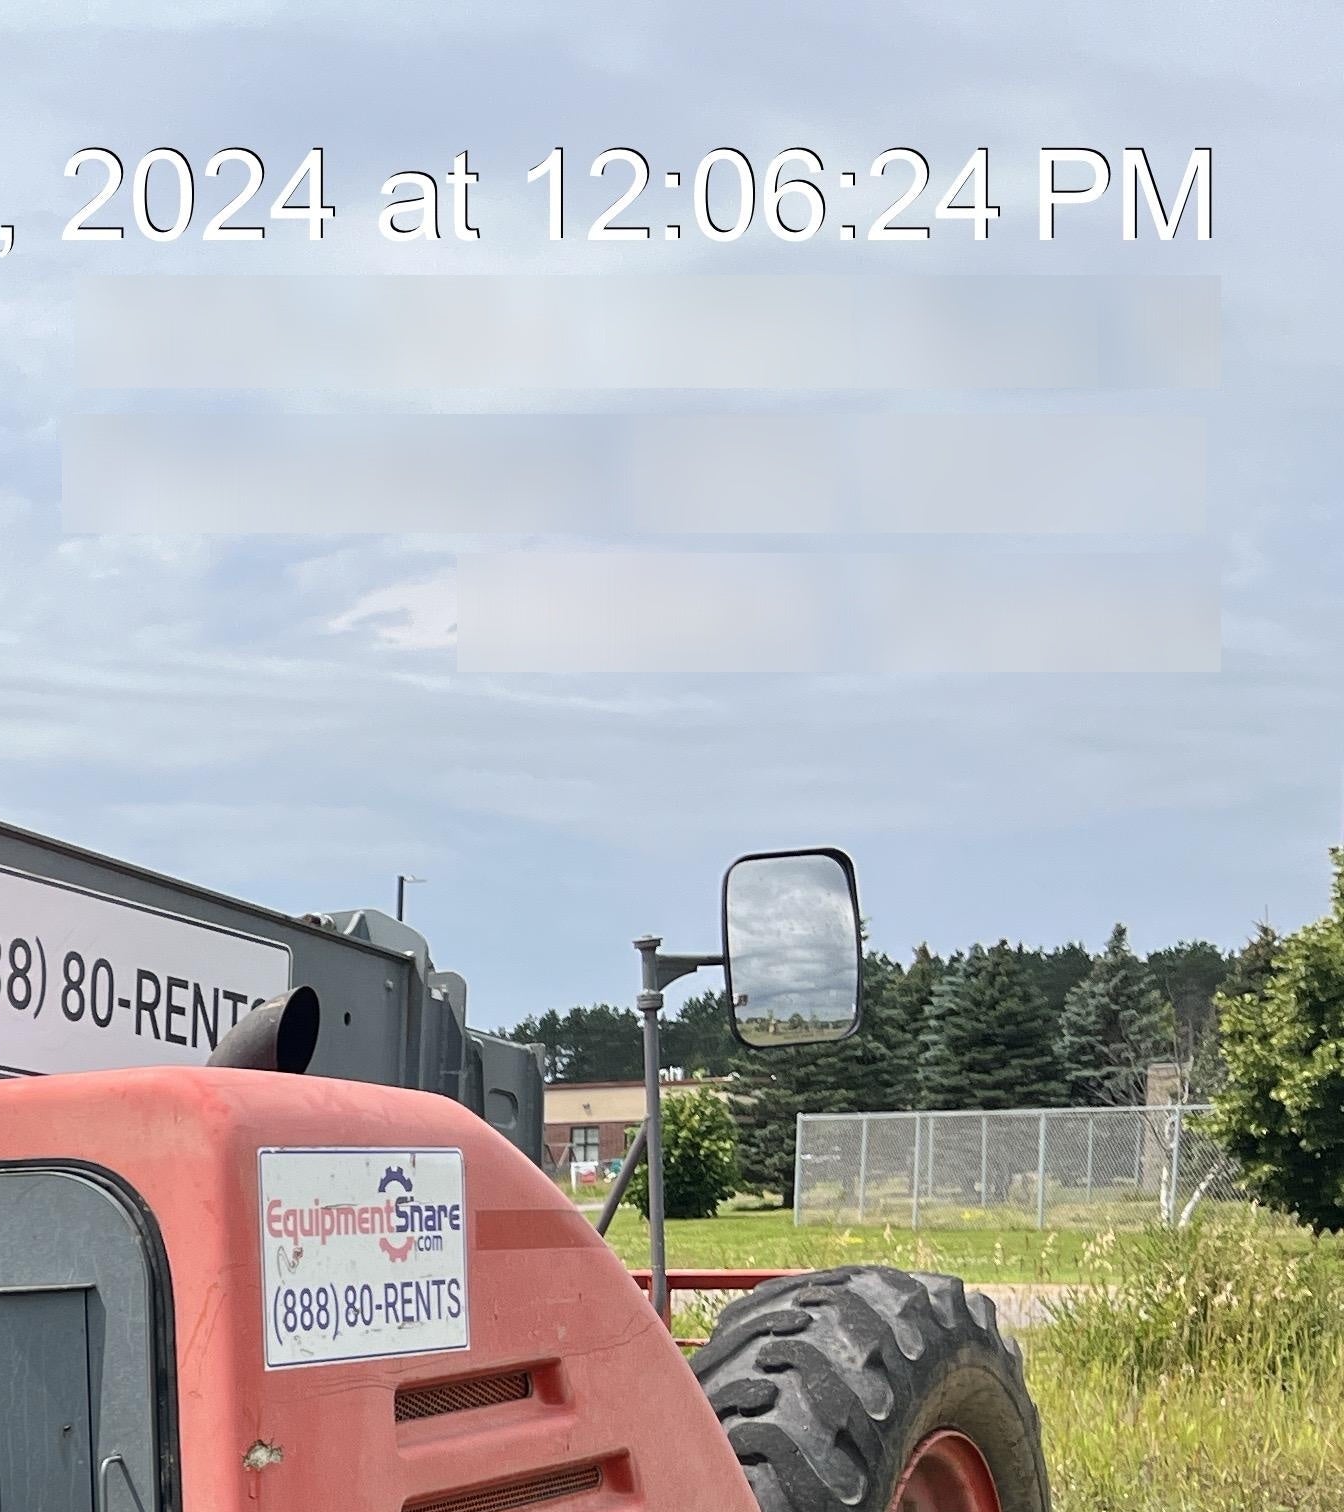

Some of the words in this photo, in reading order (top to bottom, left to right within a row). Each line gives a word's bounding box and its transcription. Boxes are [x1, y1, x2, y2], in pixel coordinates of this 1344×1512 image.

[61, 950, 266, 1052] 80-RENT
[273, 1283, 339, 1346] (888)
[344, 1277, 462, 1328] 80-RENTS
